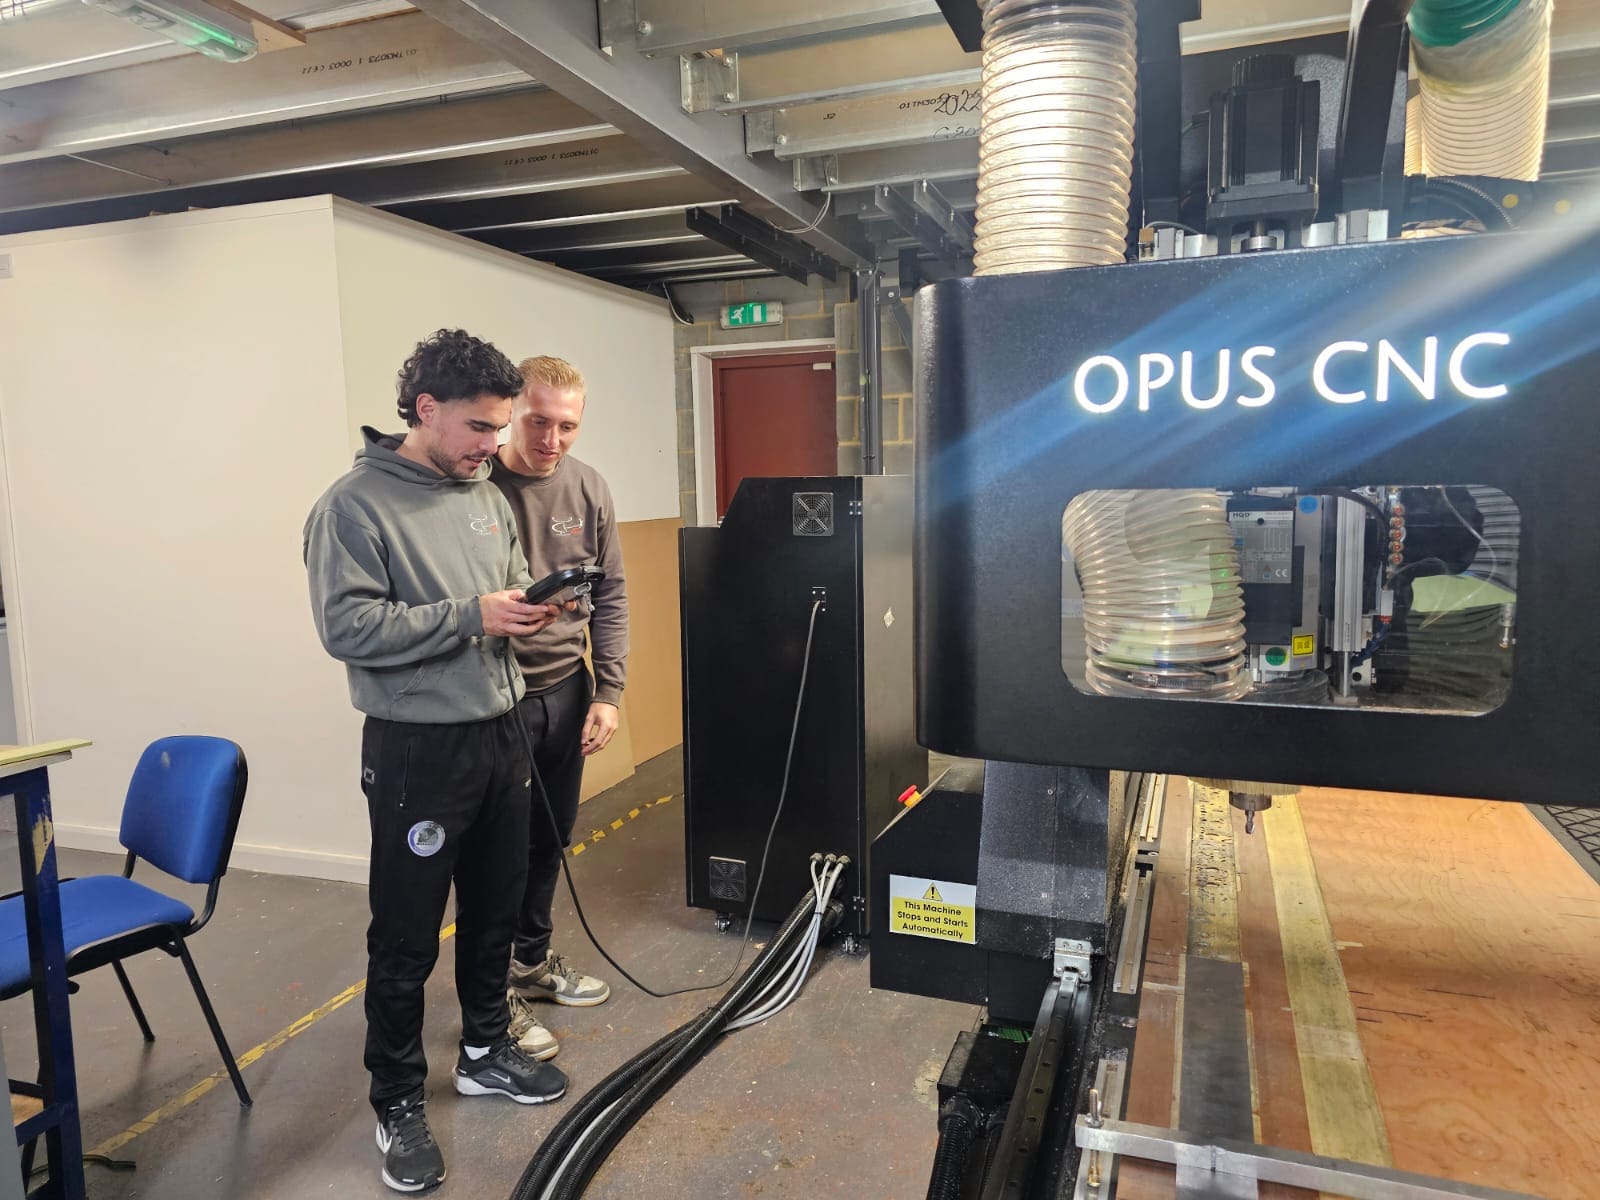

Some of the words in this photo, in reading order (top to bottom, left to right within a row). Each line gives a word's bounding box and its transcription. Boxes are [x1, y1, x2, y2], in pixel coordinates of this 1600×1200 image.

[1073, 345, 1276, 413] OPUS
[1312, 331, 1510, 404] CNC
[904, 901, 920, 909] This
[923, 903, 962, 915] Machine
[897, 911, 921, 921] Stops
[943, 917, 969, 927] Starts
[902, 922, 963, 938] Automatically
